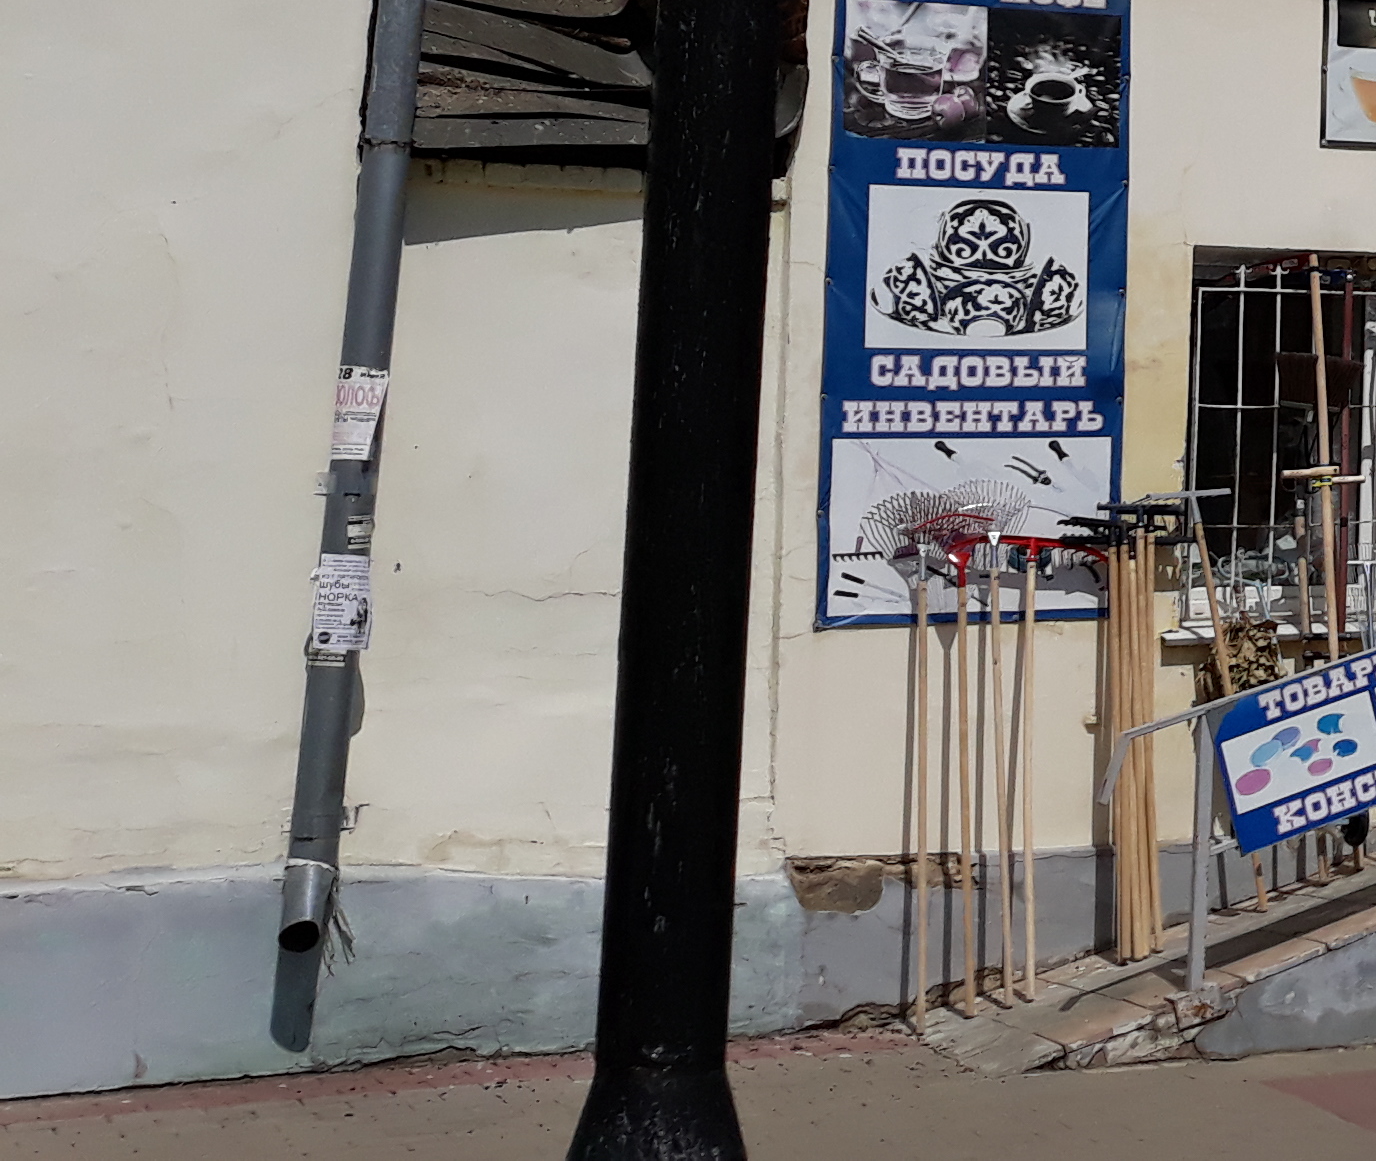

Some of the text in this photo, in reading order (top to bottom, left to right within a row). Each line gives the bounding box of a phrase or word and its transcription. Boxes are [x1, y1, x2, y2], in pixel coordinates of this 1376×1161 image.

[896, 147, 1065, 186] ПОСУДА
[870, 355, 1086, 390] САДОВЫЙ
[842, 400, 1104, 433] ИНВЕНТАРЬ
[319, 592, 358, 602] НОРКА
